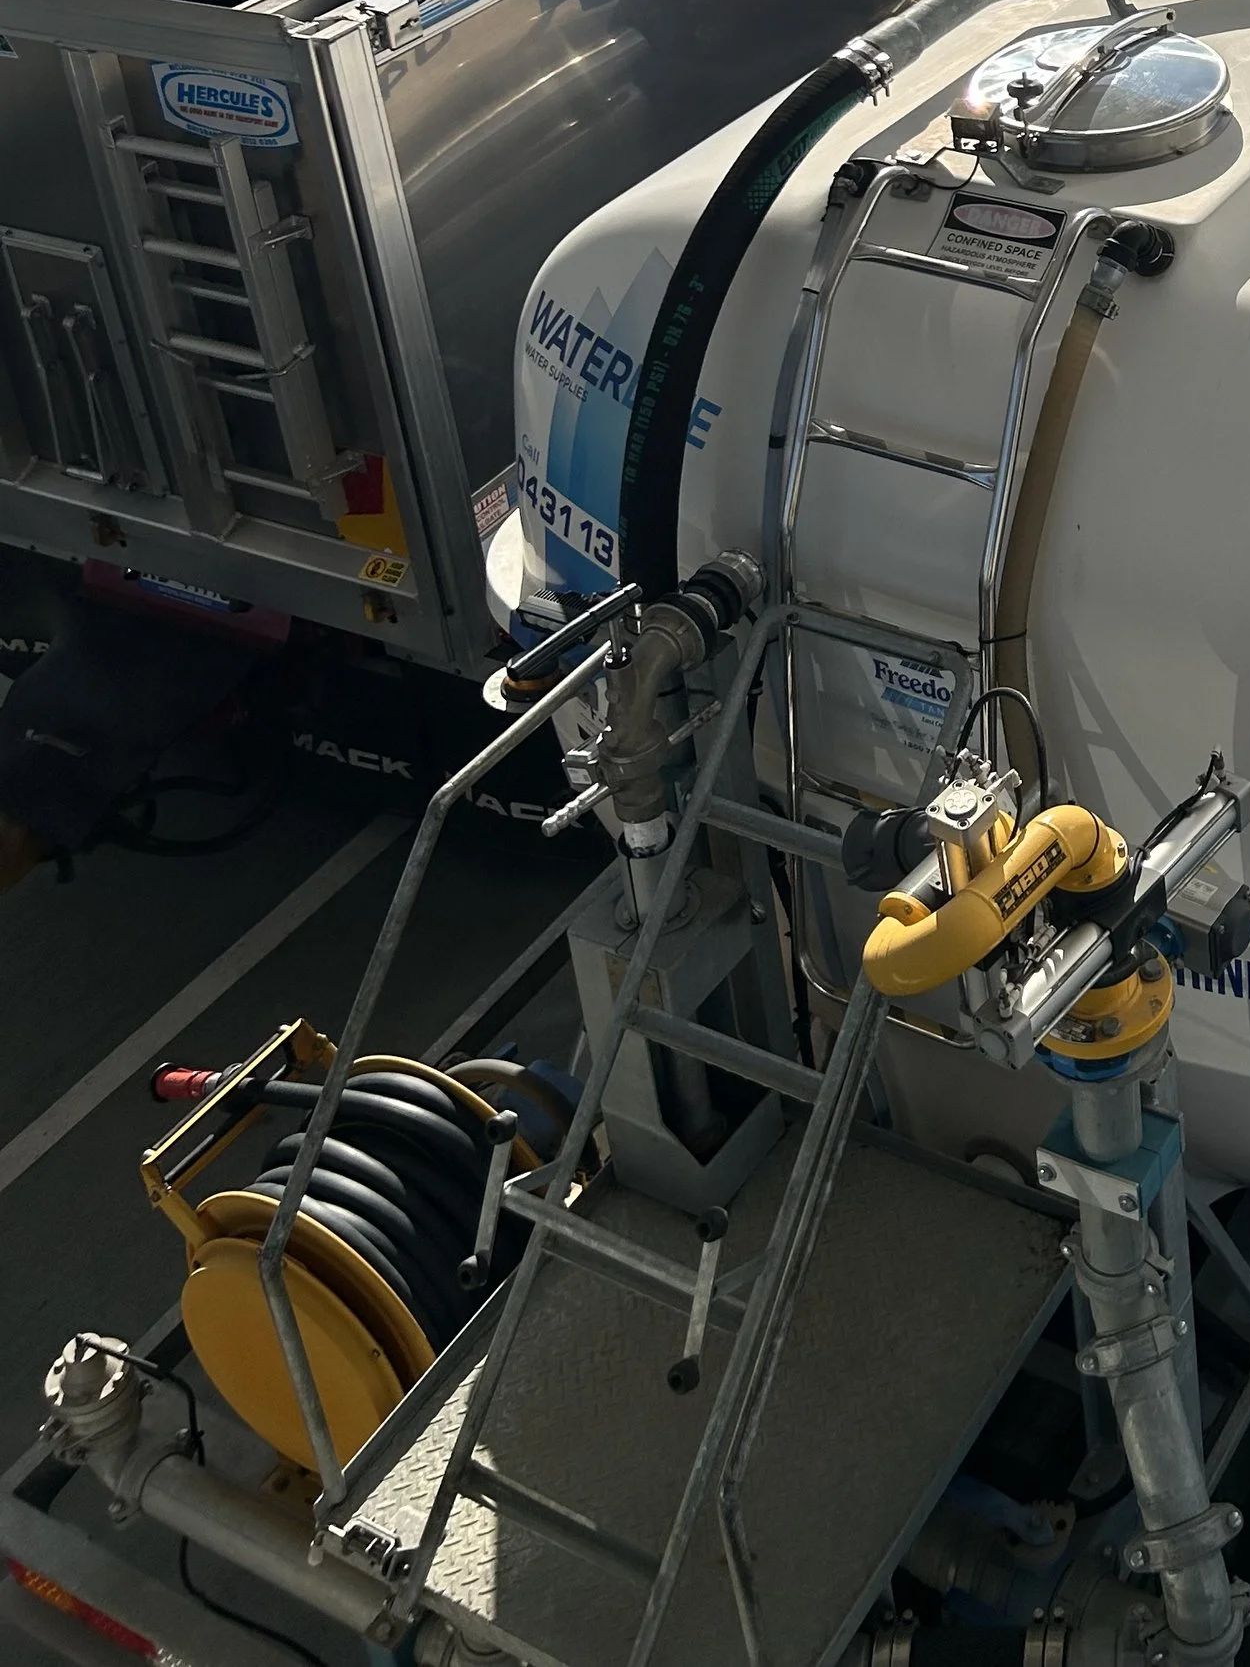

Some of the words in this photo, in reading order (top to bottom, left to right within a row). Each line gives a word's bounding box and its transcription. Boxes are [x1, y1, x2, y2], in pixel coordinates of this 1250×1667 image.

[177, 82, 274, 118] HERCULES
[967, 207, 1040, 236] DANGER
[941, 245, 986, 260] HAZARDOUS
[987, 253, 1038, 270] ATMOSPHERE
[947, 232, 1003, 252] CONFINED
[1004, 245, 1043, 261] SPACE
[525, 341, 548, 371] WATER
[548, 363, 589, 403] SUPPLIES
[529, 289, 723, 450] WATERLE
[521, 434, 540, 466] Call
[516, 453, 572, 538] 0431
[580, 518, 615, 568] 13
[872, 657, 952, 702] Freedo
[293, 730, 415, 780] MACK
